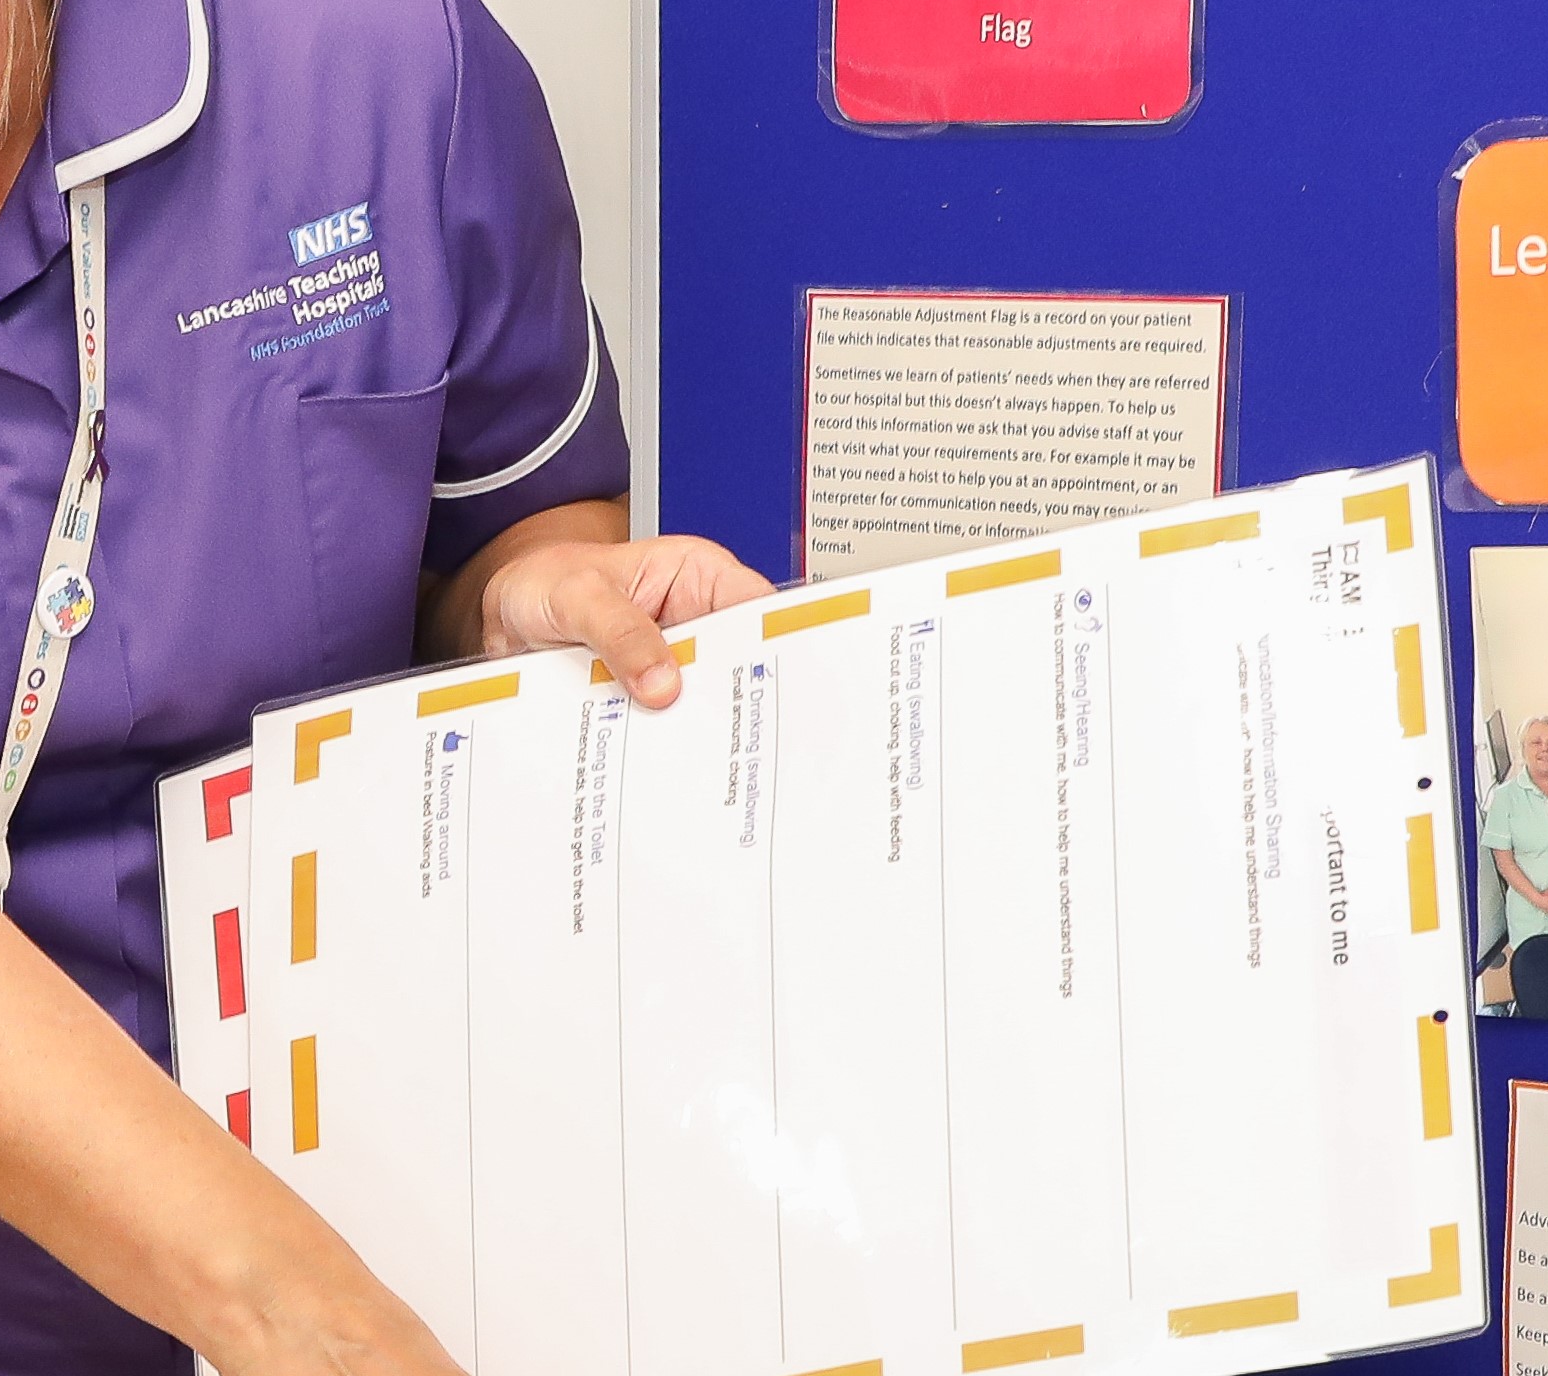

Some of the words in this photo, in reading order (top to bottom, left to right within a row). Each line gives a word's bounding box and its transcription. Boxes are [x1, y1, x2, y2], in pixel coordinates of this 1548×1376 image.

[981, 13, 1032, 47] Flag
[294, 202, 369, 263] NHS
[176, 284, 287, 334] Lancashire
[288, 250, 381, 300] Teaching
[293, 275, 384, 325] Hospitals
[817, 306, 840, 321] The
[842, 306, 912, 322] Reasonable
[914, 307, 987, 326] Adjustment
[990, 308, 1017, 327] Flag
[1019, 309, 1031, 324] is
[1033, 312, 1041, 324] a
[1044, 309, 1087, 325] record
[1089, 313, 1107, 326] on
[1109, 314, 1140, 329] your
[1143, 311, 1192, 329] patient
[251, 340, 278, 362] NHS
[282, 313, 363, 352] Foundation
[364, 298, 390, 322] Trust
[816, 329, 835, 346] file
[837, 330, 874, 347] which
[876, 331, 931, 348] indicates
[934, 332, 960, 348] that
[963, 333, 1033, 350] reasonable
[1036, 335, 1117, 354] adjustments
[1119, 339, 1142, 352] are
[1144, 338, 1207, 356] required.
[905, 635, 926, 691] Eating
[744, 687, 765, 754] Drinking
[1071, 642, 1092, 768] Seeing/Hearing
[590, 727, 613, 773] Going
[905, 694, 925, 791] (swallowing)
[435, 762, 455, 822] Moving
[591, 792, 607, 819] the
[593, 774, 607, 791] to
[739, 757, 762, 849] (swallowing)
[438, 824, 452, 881] around
[590, 820, 607, 867] Toilet
[1264, 813, 1282, 880] Sharing
[1329, 899, 1348, 923] to
[1332, 930, 1348, 966] me
[1517, 1246, 1536, 1266] Be
[1540, 1254, 1548, 1268] a
